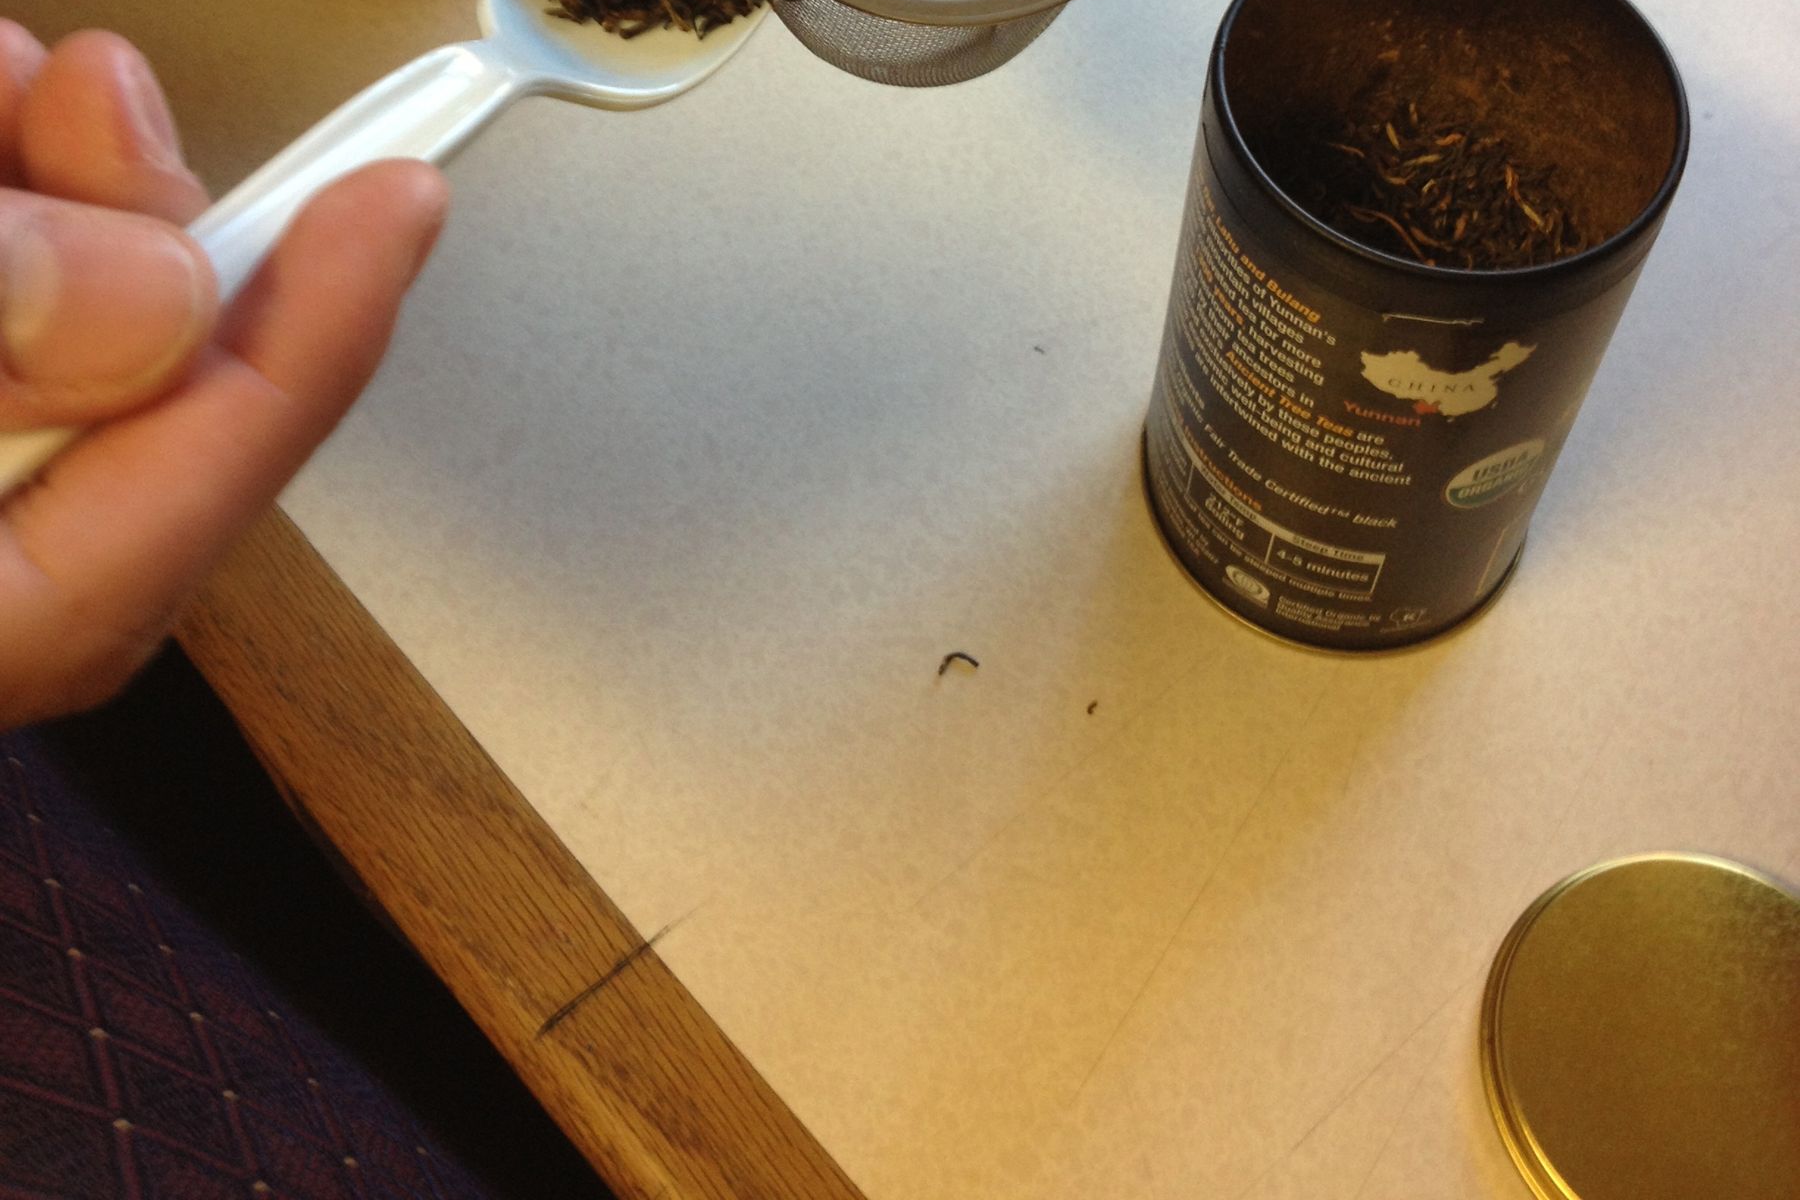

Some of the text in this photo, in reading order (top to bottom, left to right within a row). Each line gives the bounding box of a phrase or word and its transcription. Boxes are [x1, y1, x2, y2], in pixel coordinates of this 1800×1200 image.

[1240, 254, 1266, 281] and
[1266, 279, 1321, 323] Bulang
[1252, 283, 1267, 299] of
[1269, 295, 1337, 346] Yunnan's
[1252, 297, 1305, 345] villages
[1237, 330, 1257, 354] tea
[1258, 352, 1295, 384] trees
[1238, 298, 1257, 325] tea
[1260, 322, 1279, 341] for
[1282, 339, 1322, 369] more
[1248, 326, 1325, 386] harvesting
[1225, 350, 1276, 398] Ancient
[1279, 395, 1312, 421] Tree
[1315, 414, 1354, 438] Teas
[1356, 430, 1385, 446] are
[1231, 341, 1297, 398] ancestors
[1299, 392, 1315, 409] in
[1387, 376, 1476, 394] CHINA
[1209, 374, 1279, 443] intertwined
[1281, 438, 1315, 463] with
[1318, 450, 1345, 474] the
[1348, 465, 1412, 486] ancient
[1231, 383, 1301, 443] well-being
[1304, 433, 1336, 458] and
[1338, 451, 1404, 473] cultural
[1257, 393, 1276, 414] by
[1278, 405, 1320, 438] these
[1323, 434, 1393, 461] peoples.
[1344, 400, 1422, 427] Yunnan
[1204, 423, 1226, 448] Fair
[1228, 449, 1262, 481] Trade
[1352, 513, 1398, 529] black
[1277, 550, 1369, 583] 4-5 minutes
[1293, 535, 1365, 561] Steep Time
